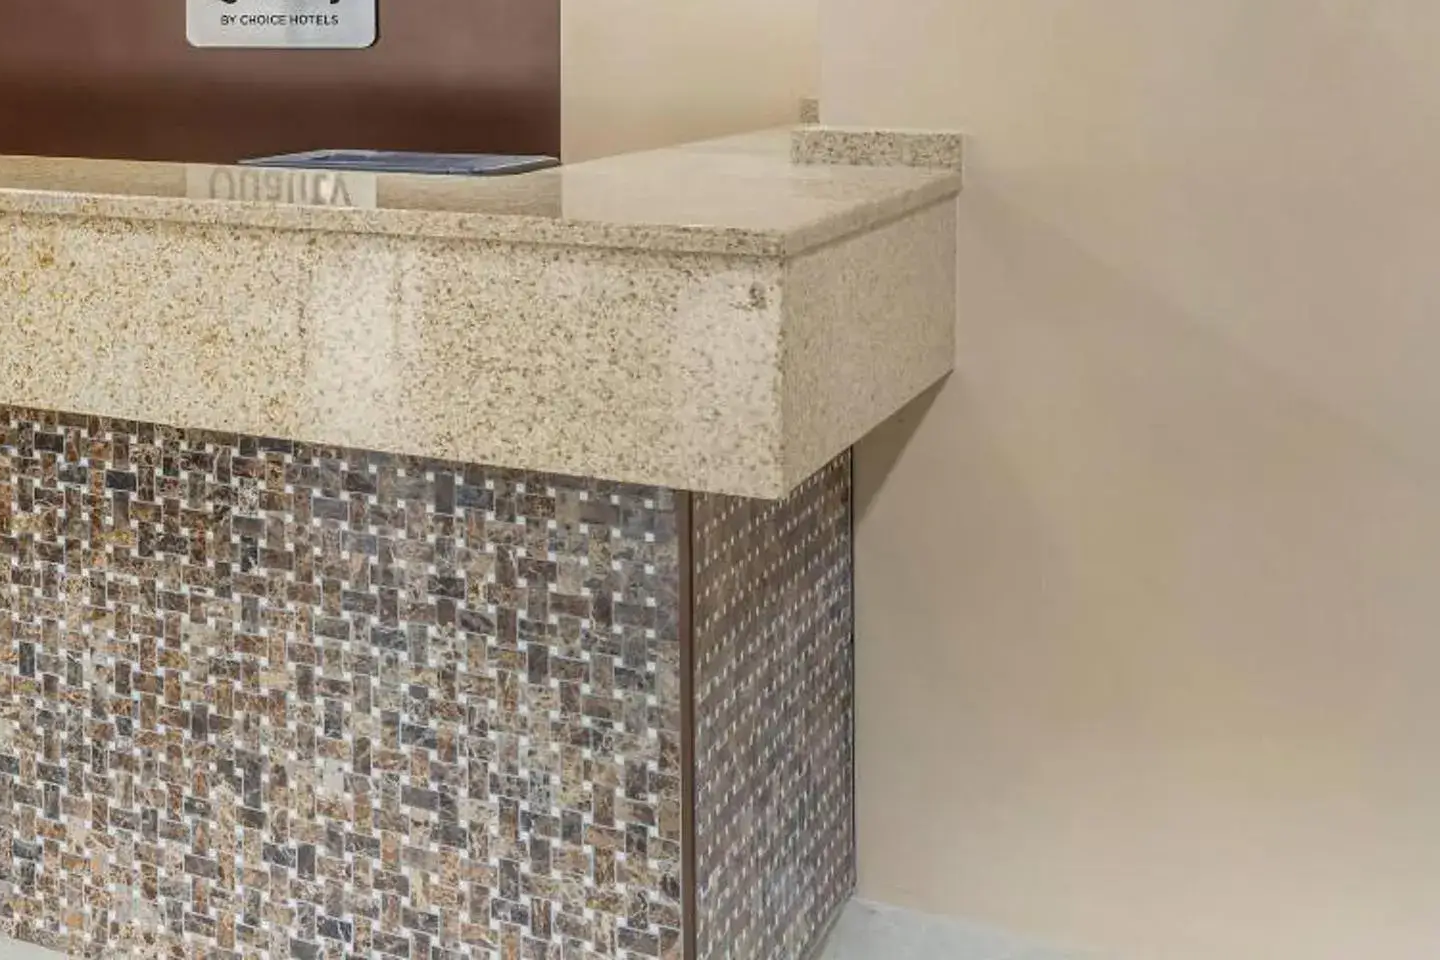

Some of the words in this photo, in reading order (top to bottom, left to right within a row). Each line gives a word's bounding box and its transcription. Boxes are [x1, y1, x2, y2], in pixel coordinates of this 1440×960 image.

[221, 15, 236, 25] BY
[240, 14, 287, 25] CHOICE
[289, 14, 339, 25] HOTELS
